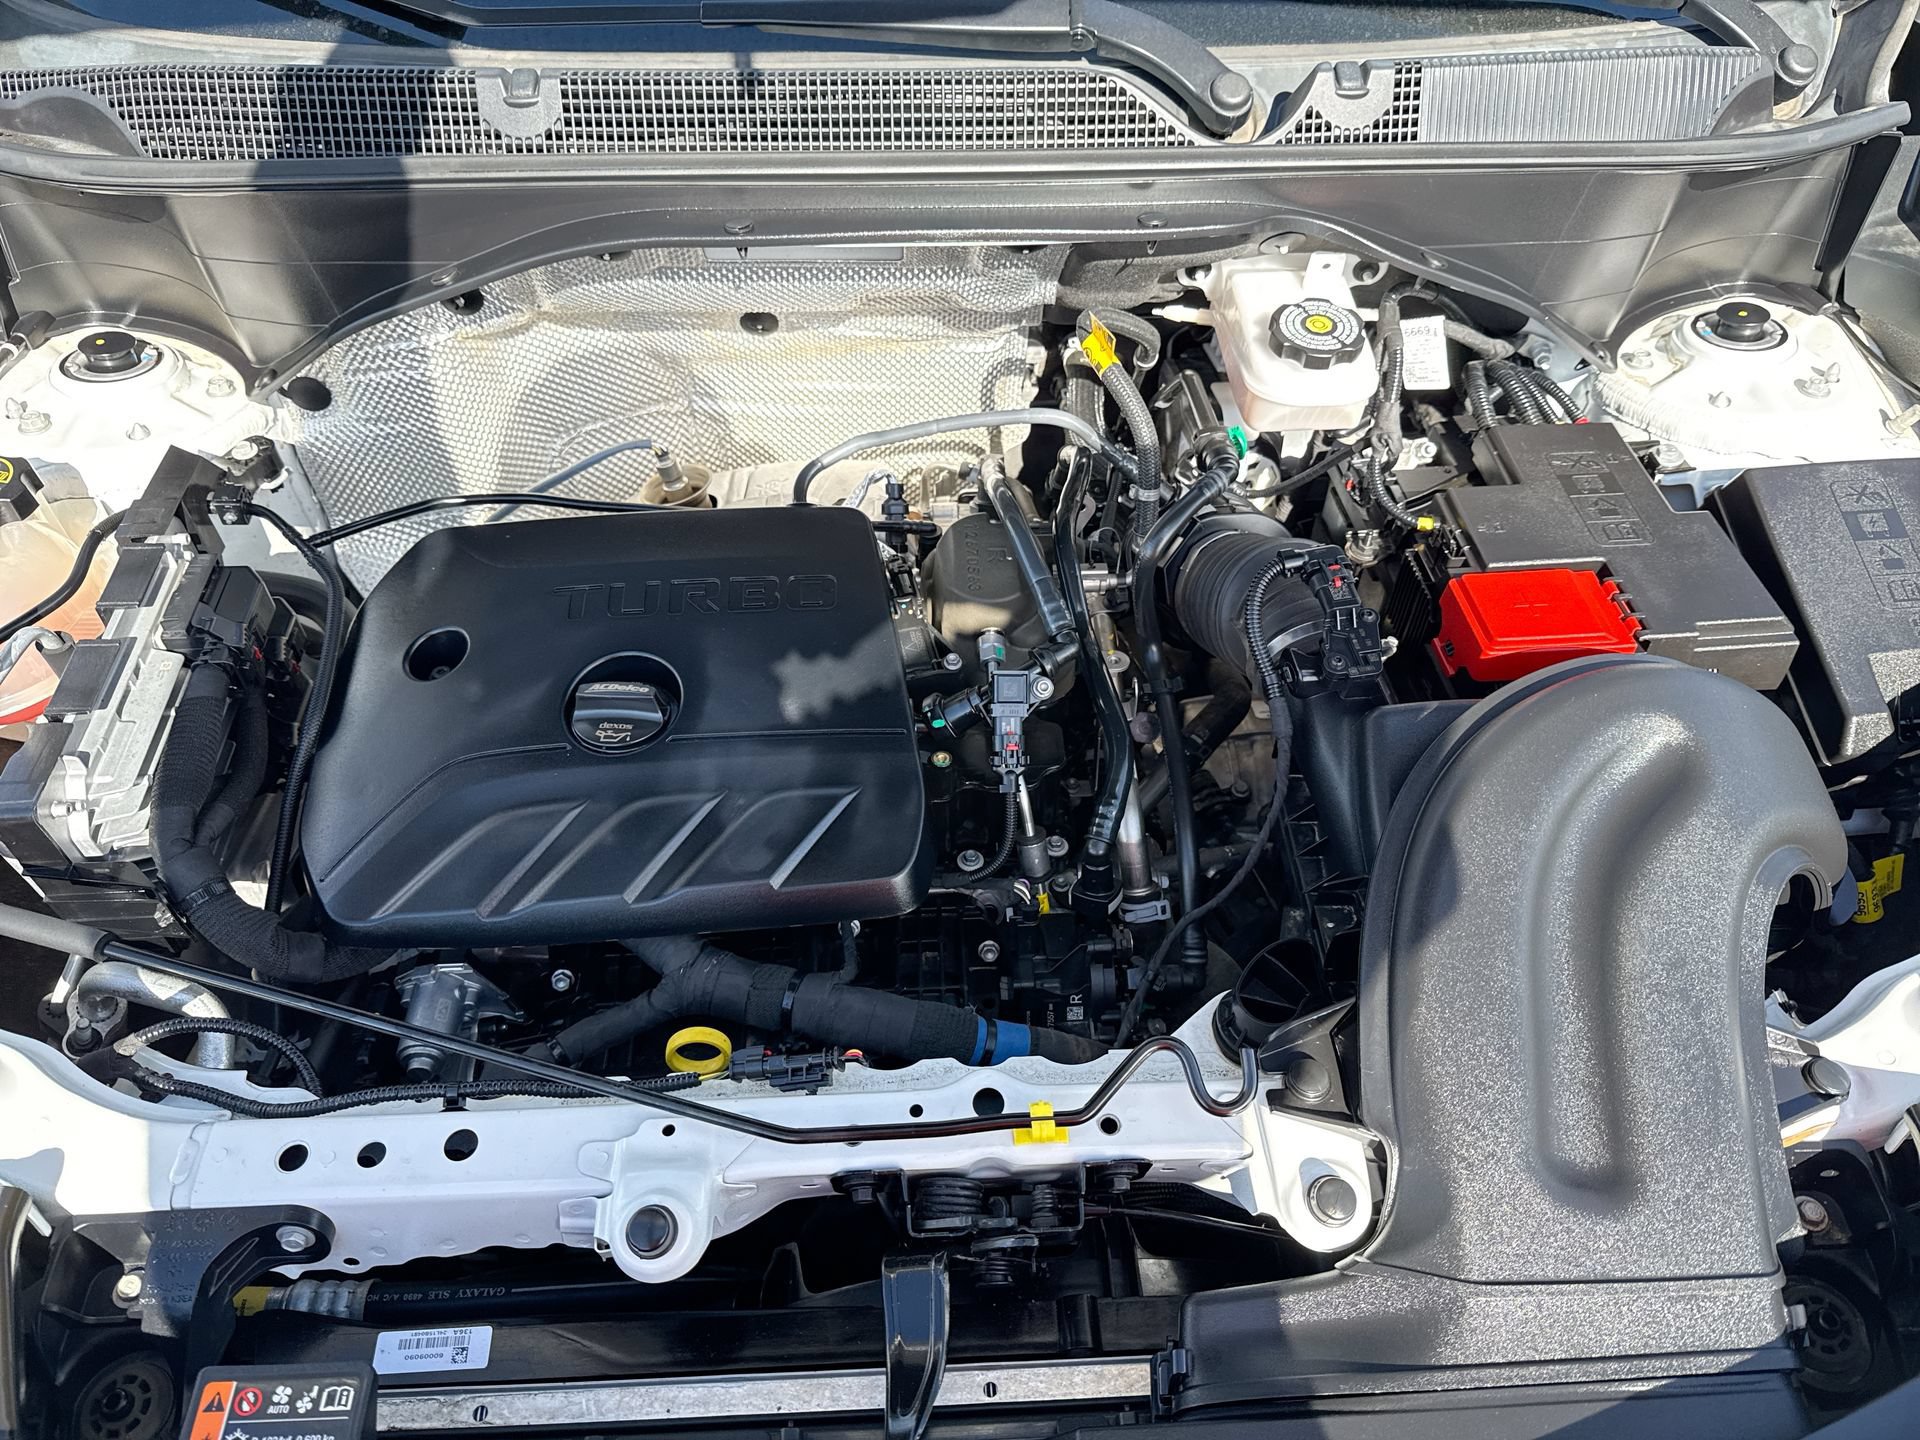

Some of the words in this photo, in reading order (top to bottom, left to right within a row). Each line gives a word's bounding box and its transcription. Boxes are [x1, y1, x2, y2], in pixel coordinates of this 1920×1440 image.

[553, 574, 838, 621] TURBO
[584, 683, 650, 694] ACDelco
[599, 721, 634, 730] dexos
[1069, 993, 1083, 1004] R
[383, 1293, 400, 1302] A/C
[428, 1289, 451, 1300] SLE
[455, 1286, 506, 1299] GALAXY
[404, 1352, 444, 1361] 60009090
[266, 1404, 291, 1415] AUTO
